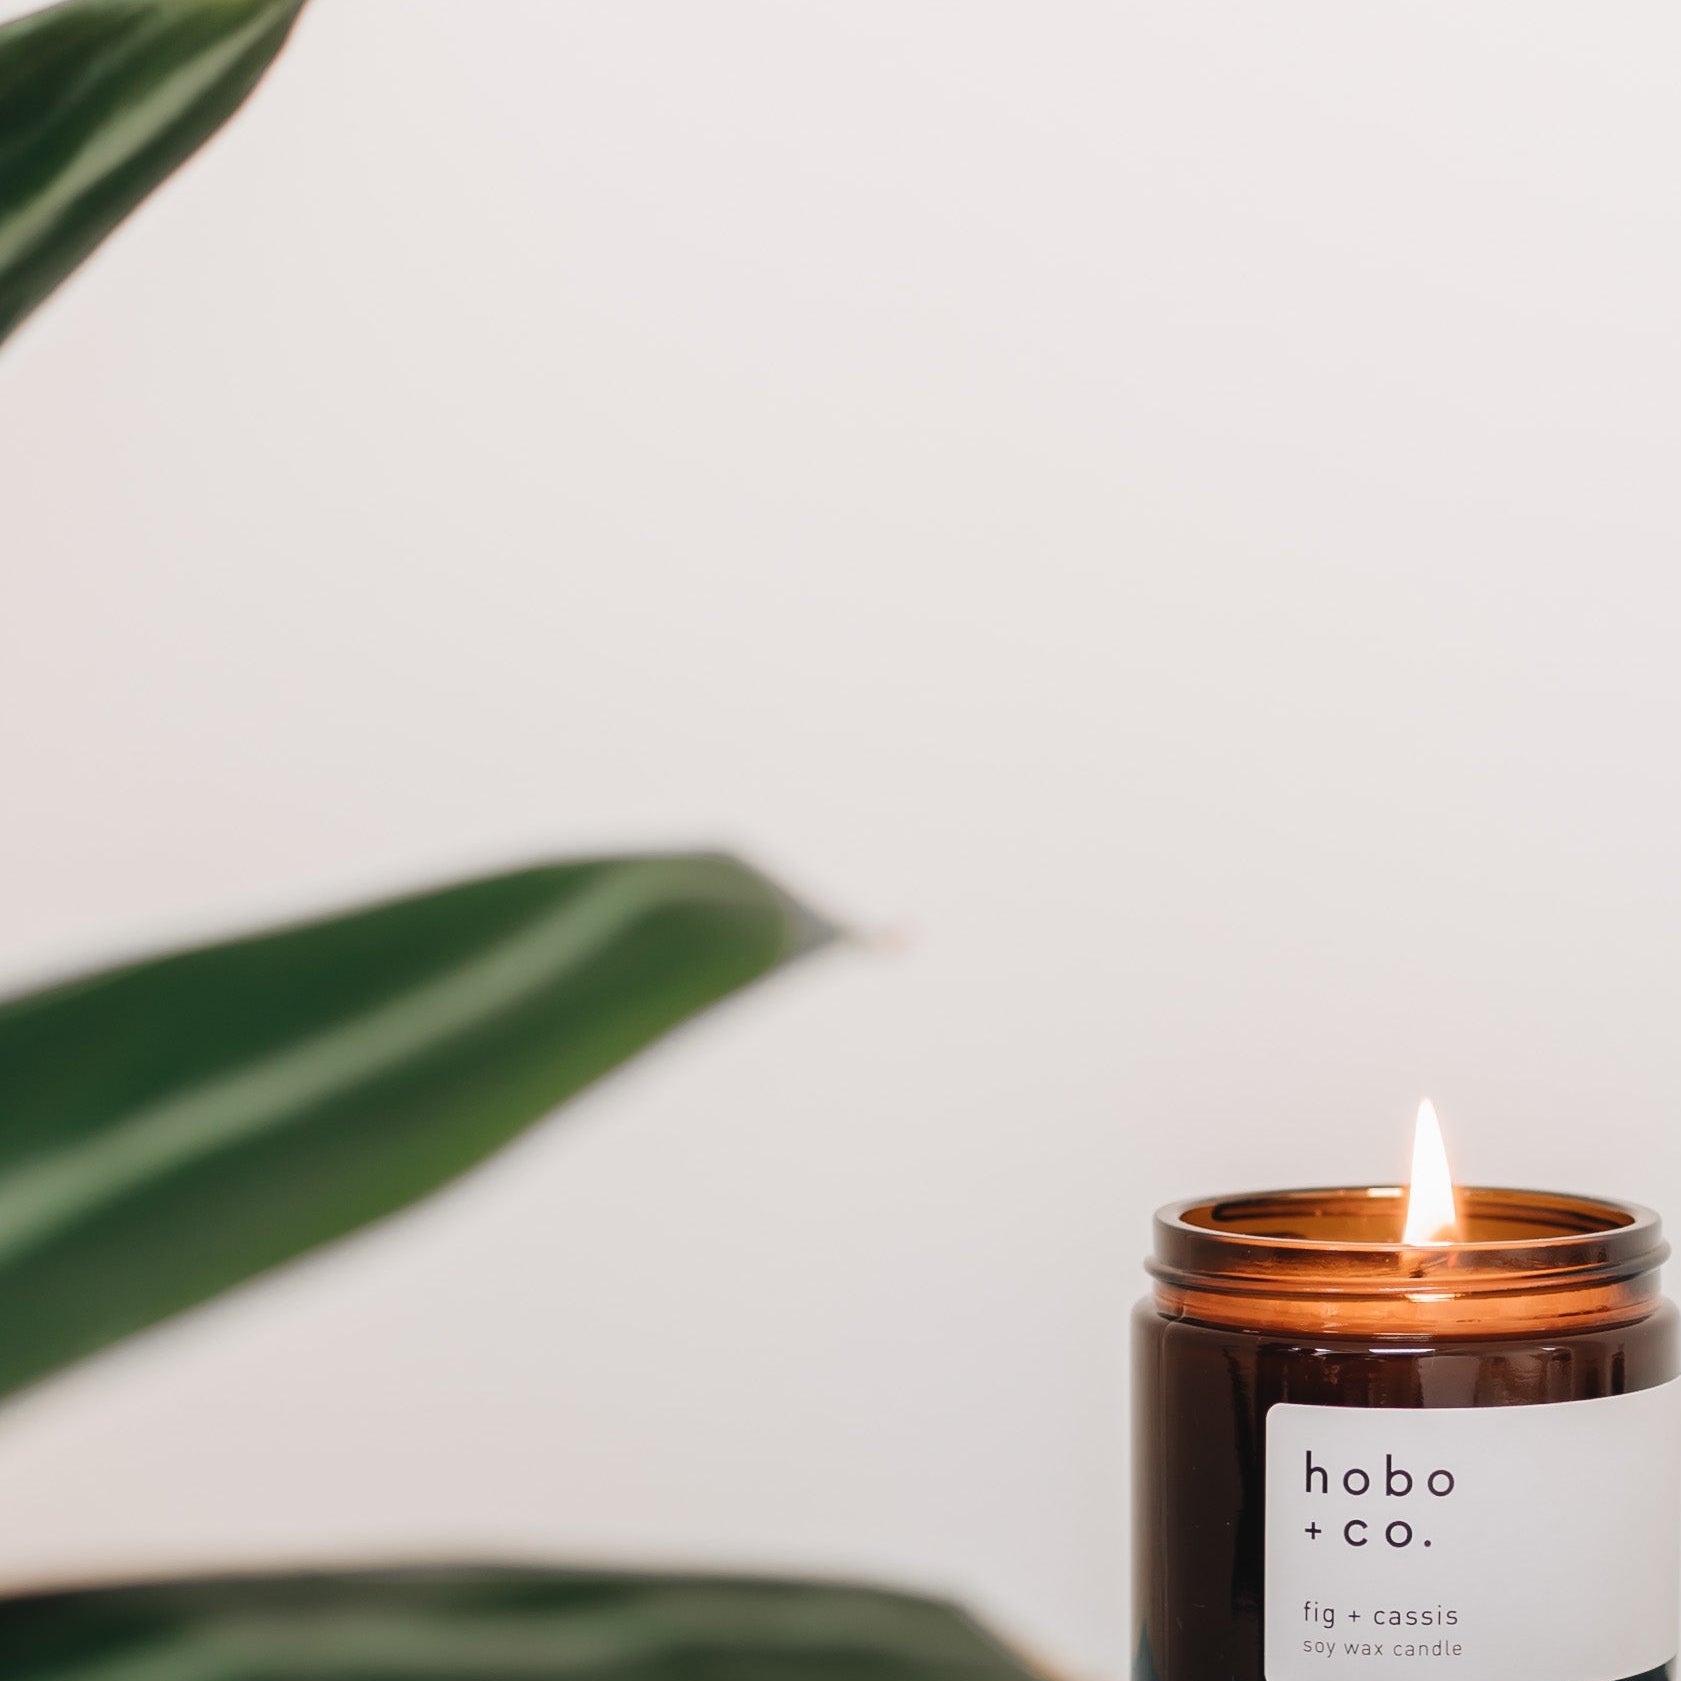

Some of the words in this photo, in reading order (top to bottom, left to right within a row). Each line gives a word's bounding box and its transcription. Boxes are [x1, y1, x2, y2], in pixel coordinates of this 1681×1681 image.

[1305, 1450, 1455, 1498] hobo
[1304, 1521, 1322, 1541] +
[1343, 1519, 1432, 1548] co.
[1303, 1600, 1335, 1629] fig
[1348, 1610, 1361, 1623] +
[1373, 1604, 1458, 1627] cassis
[1303, 1639, 1336, 1659] soy
[1343, 1643, 1383, 1657] wax
[1393, 1639, 1462, 1658] candle
